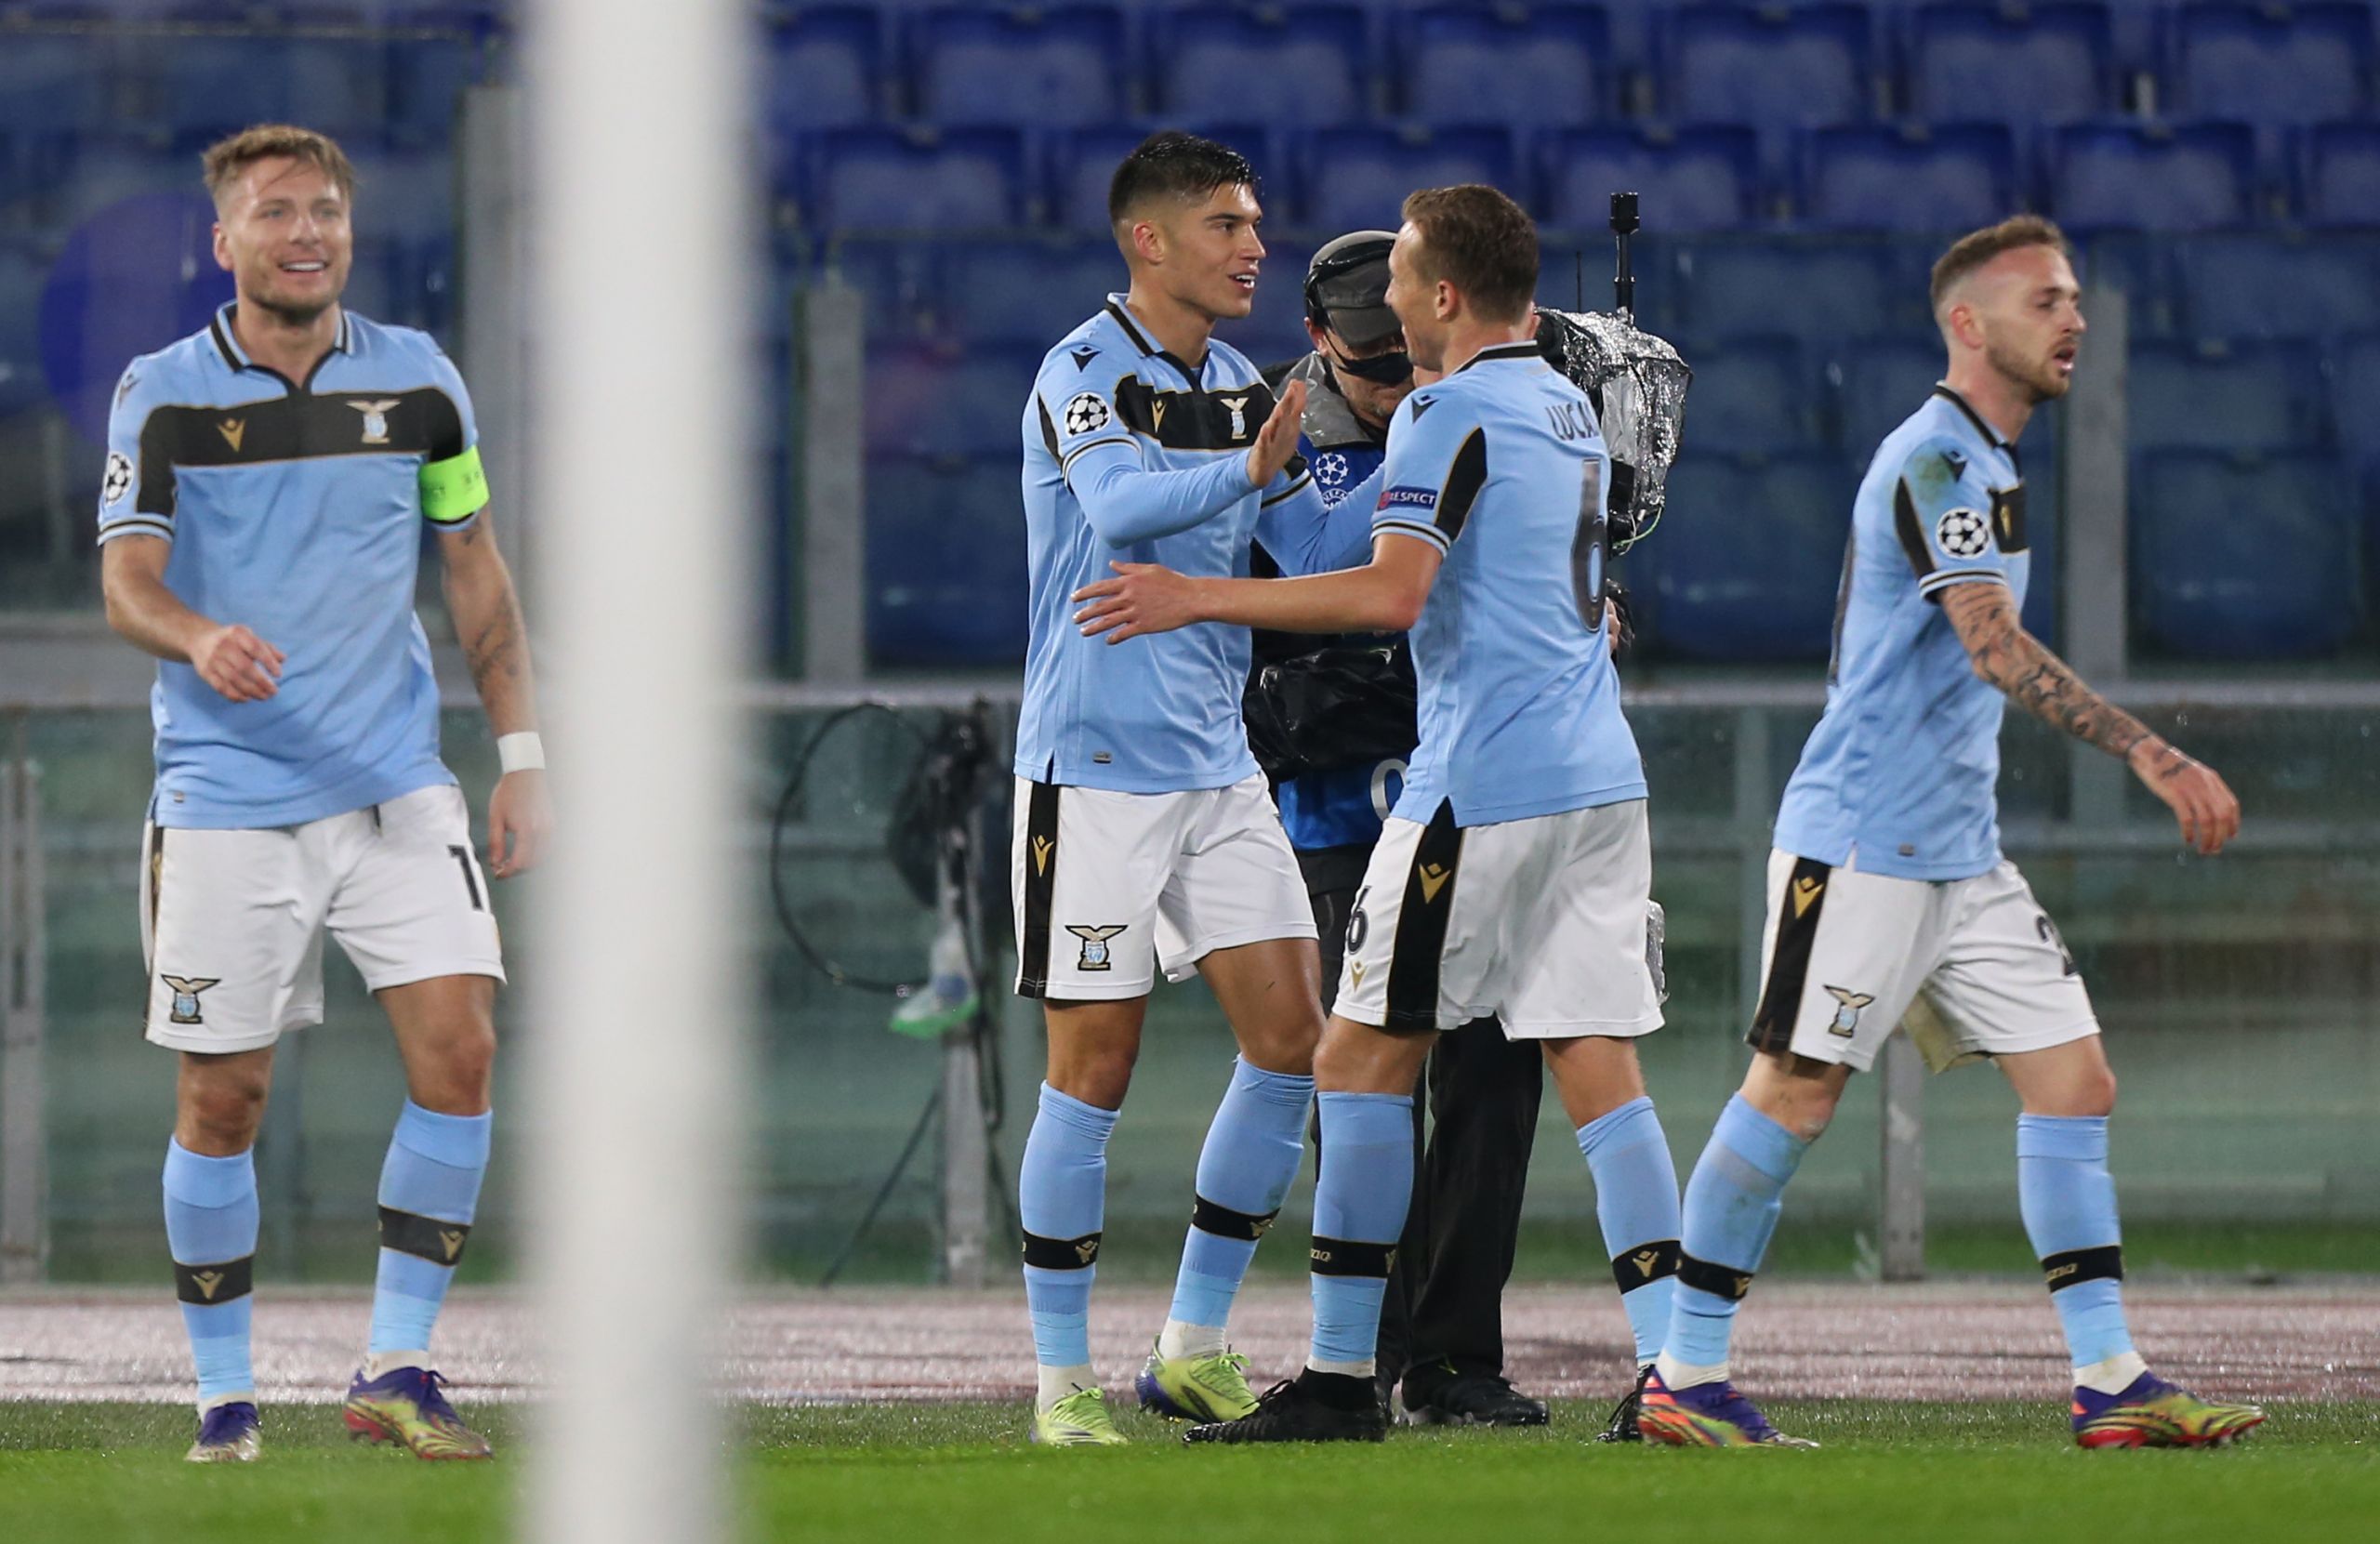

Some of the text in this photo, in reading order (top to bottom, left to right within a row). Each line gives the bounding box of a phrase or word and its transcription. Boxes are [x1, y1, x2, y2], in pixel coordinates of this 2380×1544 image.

[1390, 491, 1435, 505] RESPECT
[1569, 458, 1607, 632] 6
[446, 845, 483, 911] 1
[1347, 885, 1371, 956] 6
